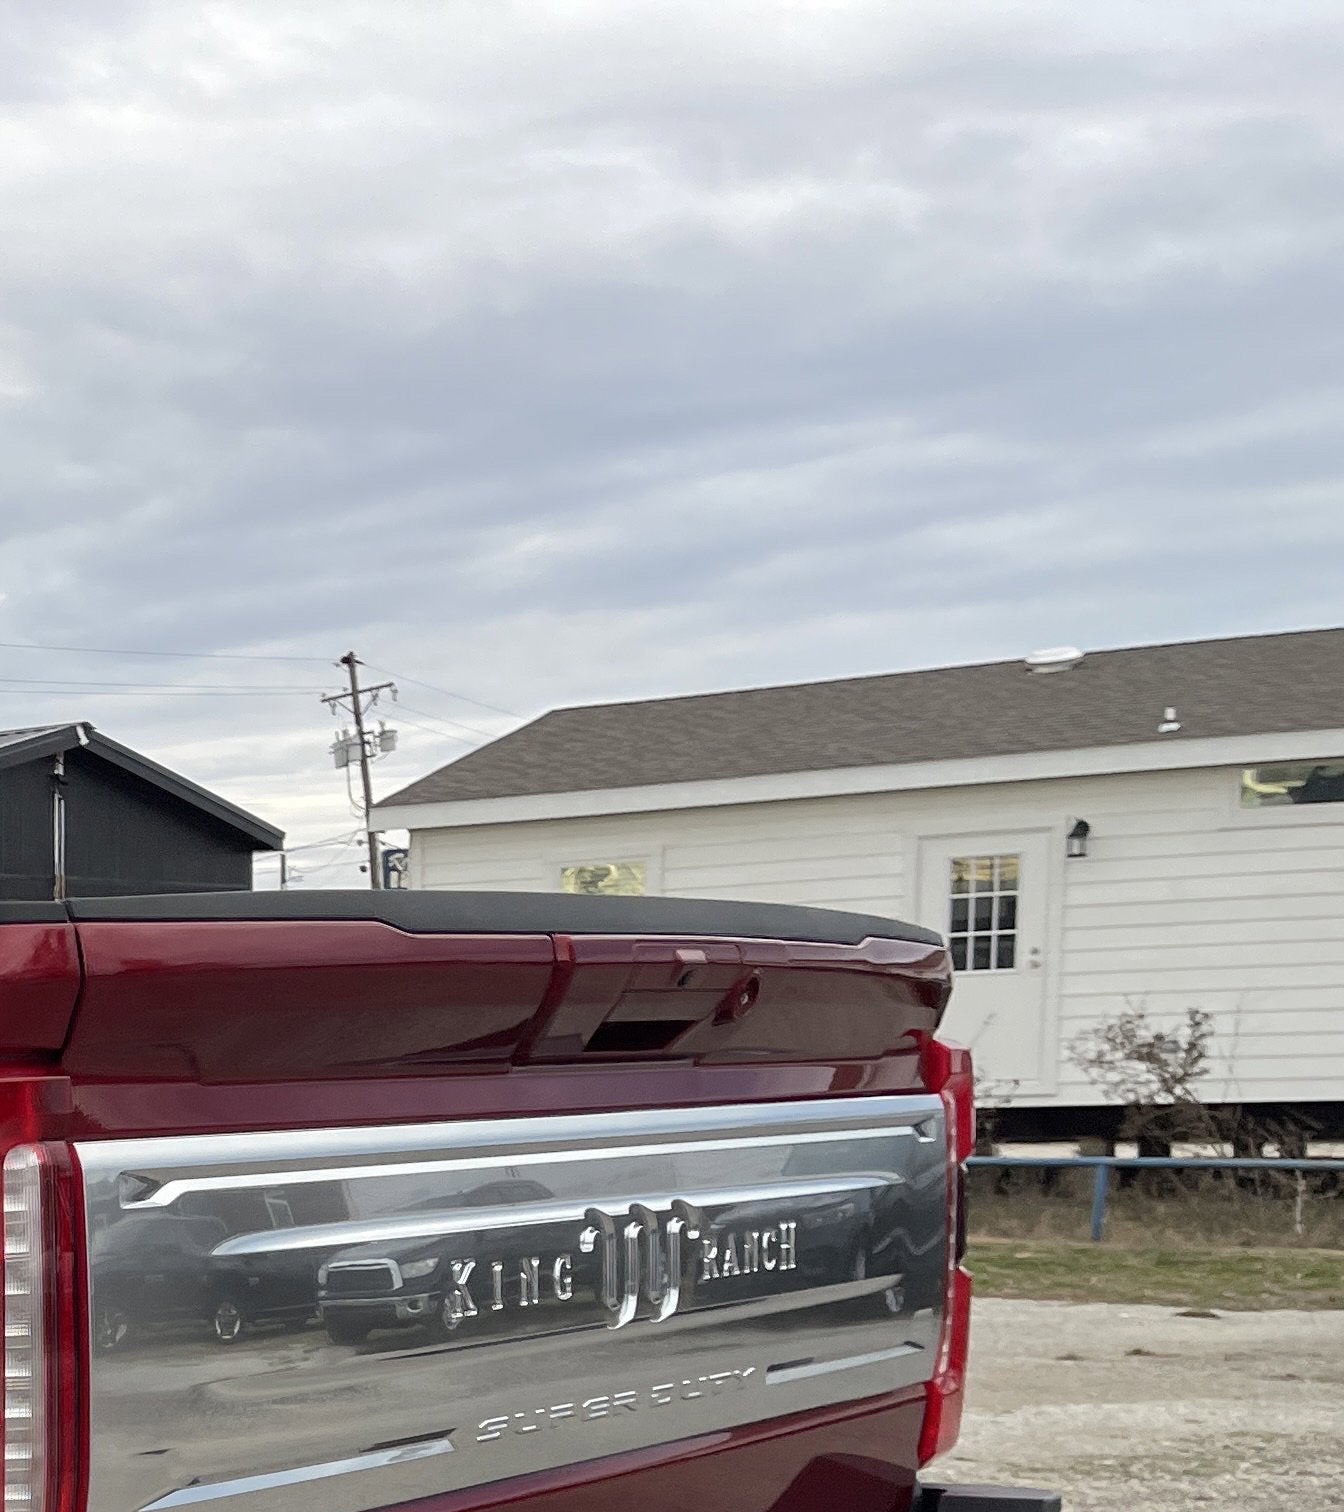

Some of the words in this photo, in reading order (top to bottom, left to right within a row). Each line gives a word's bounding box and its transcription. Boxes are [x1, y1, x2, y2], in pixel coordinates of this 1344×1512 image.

[449, 1254, 574, 1319] KING
[701, 1220, 798, 1281] RANCH
[475, 1389, 639, 1442] SUPER
[650, 1366, 757, 1408] DUTY
